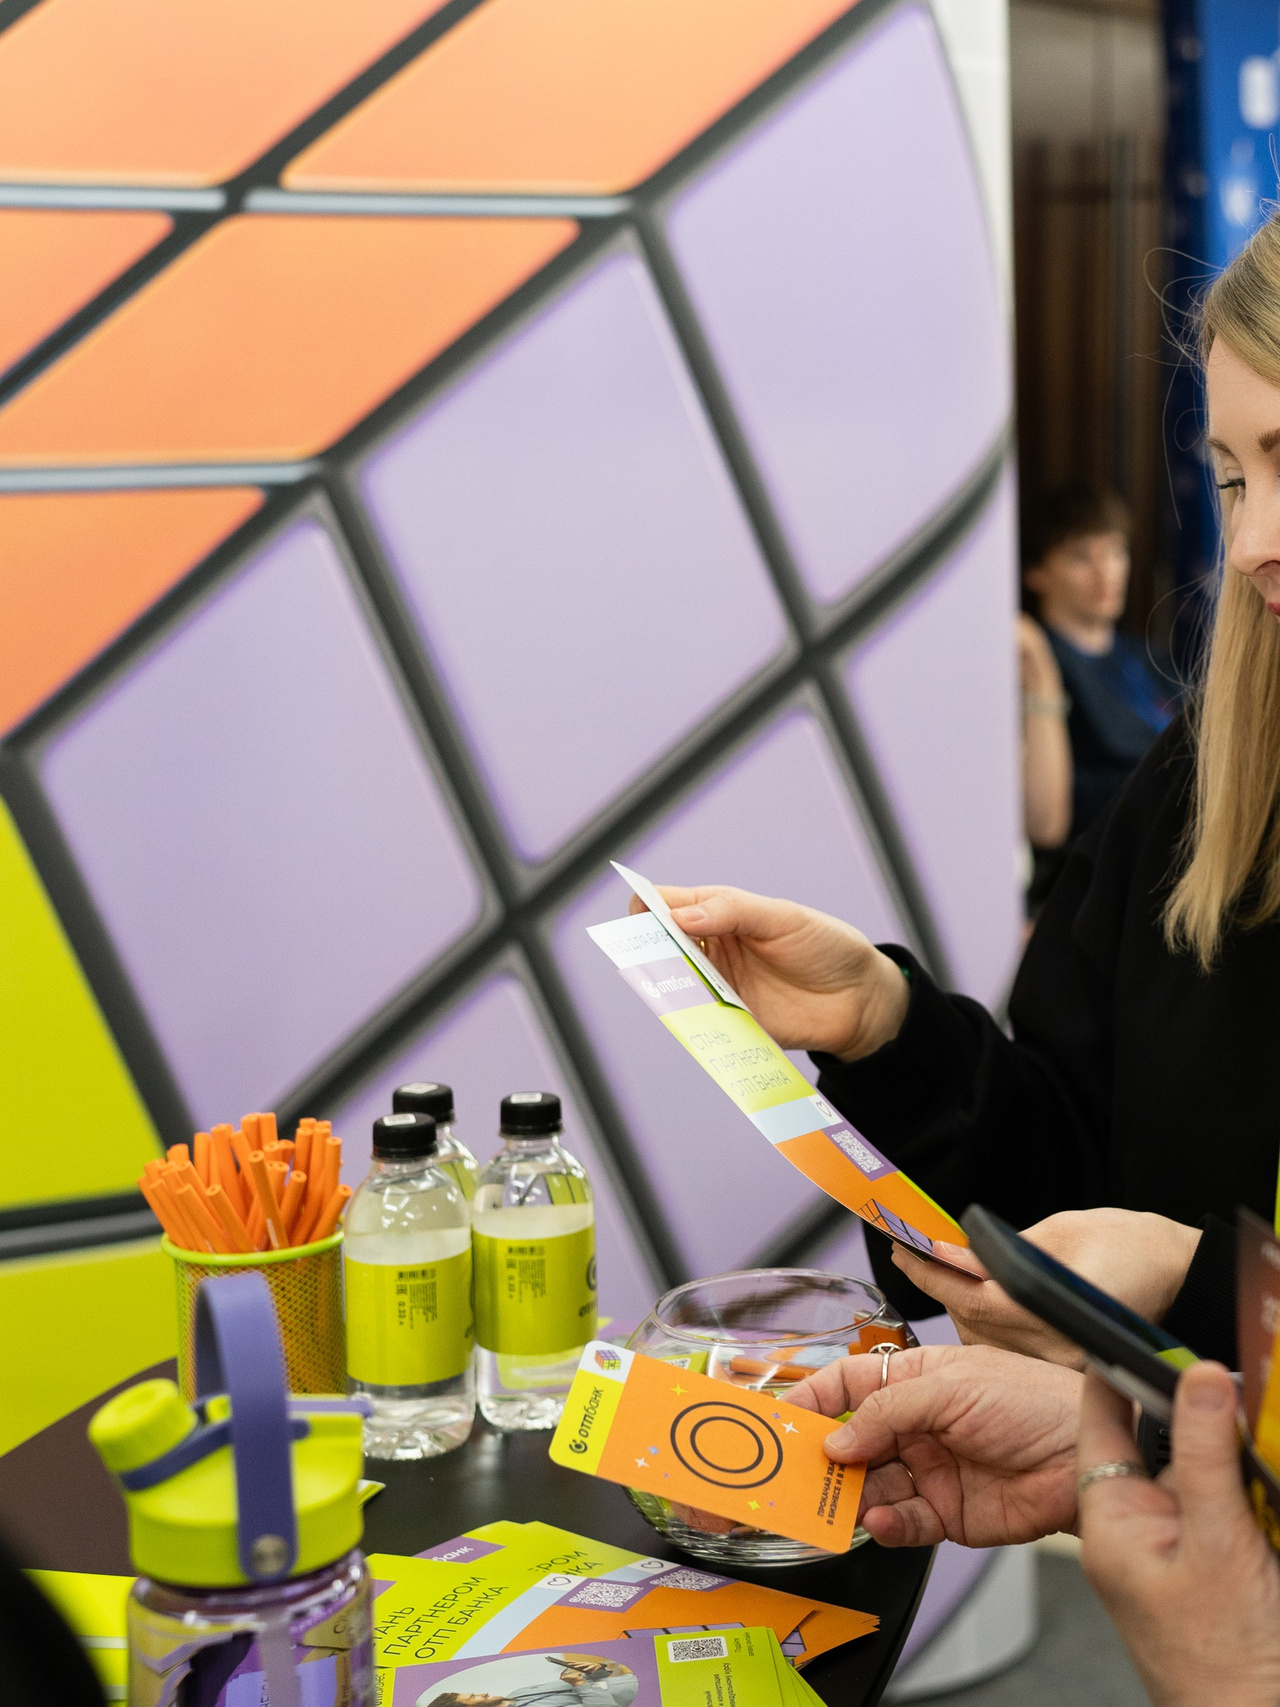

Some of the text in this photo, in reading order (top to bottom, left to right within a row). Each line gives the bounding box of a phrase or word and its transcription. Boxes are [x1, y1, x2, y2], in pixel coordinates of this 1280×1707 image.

[690, 1029, 731, 1051] СТАНЬ
[709, 1046, 777, 1074] ПАРТНЕРОМ
[730, 1069, 792, 1097] ОТП БАНКА
[581, 1386, 604, 1438] отпбанк
[817, 1459, 836, 1516] ПРОКАЧАЙ ХВА
[828, 1485, 841, 1519] БИЗНЕСЕ
[383, 1576, 487, 1656] ПАРТНЕРОМ
[414, 1586, 509, 1660] ОТП БАНКА
